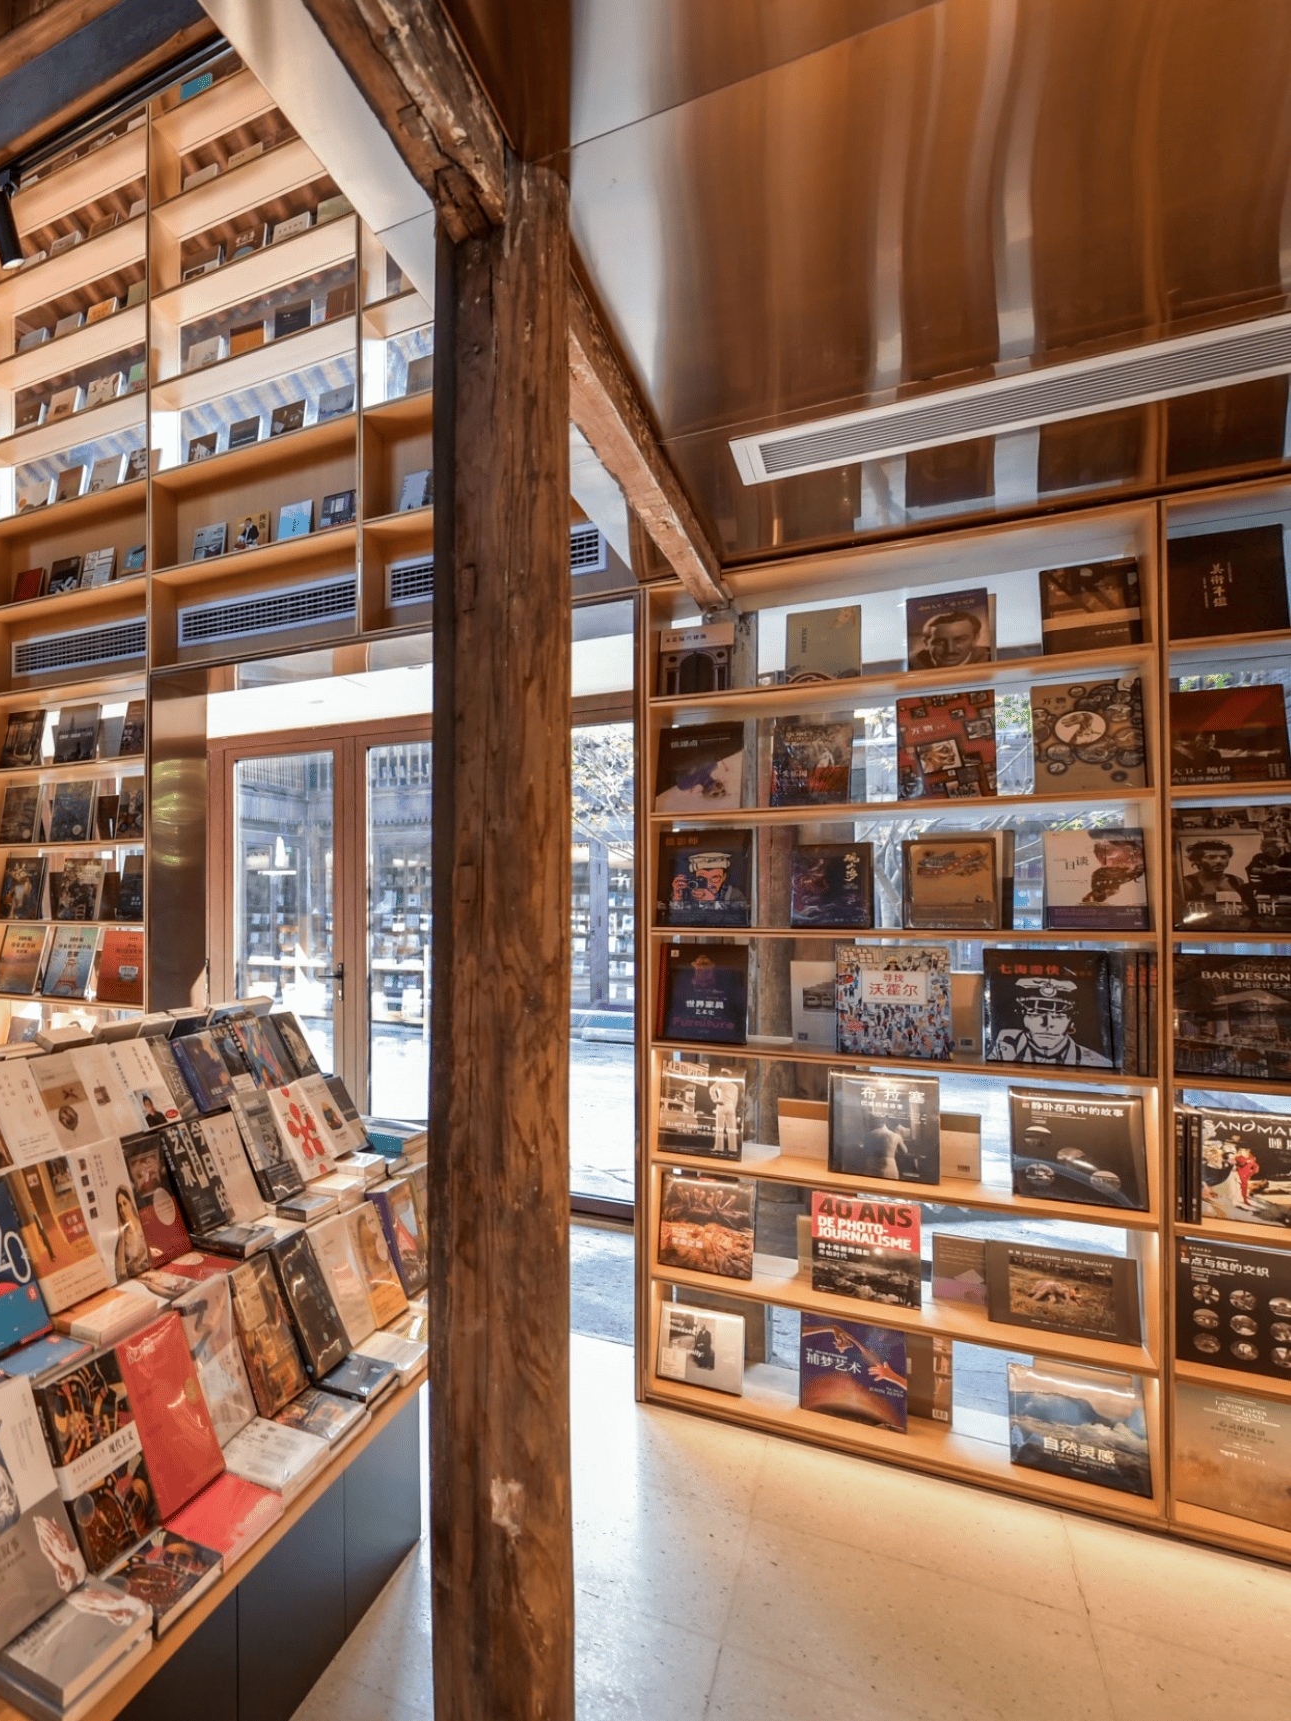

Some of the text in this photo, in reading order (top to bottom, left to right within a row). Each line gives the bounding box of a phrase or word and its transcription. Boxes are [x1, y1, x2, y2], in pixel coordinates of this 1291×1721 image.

[883, 973, 905, 983] 寻找
[1201, 970, 1291, 982] BAR DESIGN
[869, 982, 919, 997] 沃霍尔
[685, 999, 724, 1010] 世界家具
[860, 1086, 926, 1104] 布拉塞
[1031, 1101, 1124, 1119] 静卧在风中的故事
[818, 1199, 913, 1229] 40 ANS
[817, 1215, 889, 1233] DE PHOTO-
[817, 1226, 912, 1251] JOURNALISME
[1191, 1257, 1271, 1278] 点与线的交织
[806, 1351, 861, 1375] 捕梦艺术
[1043, 1436, 1116, 1465] 自然灵感
